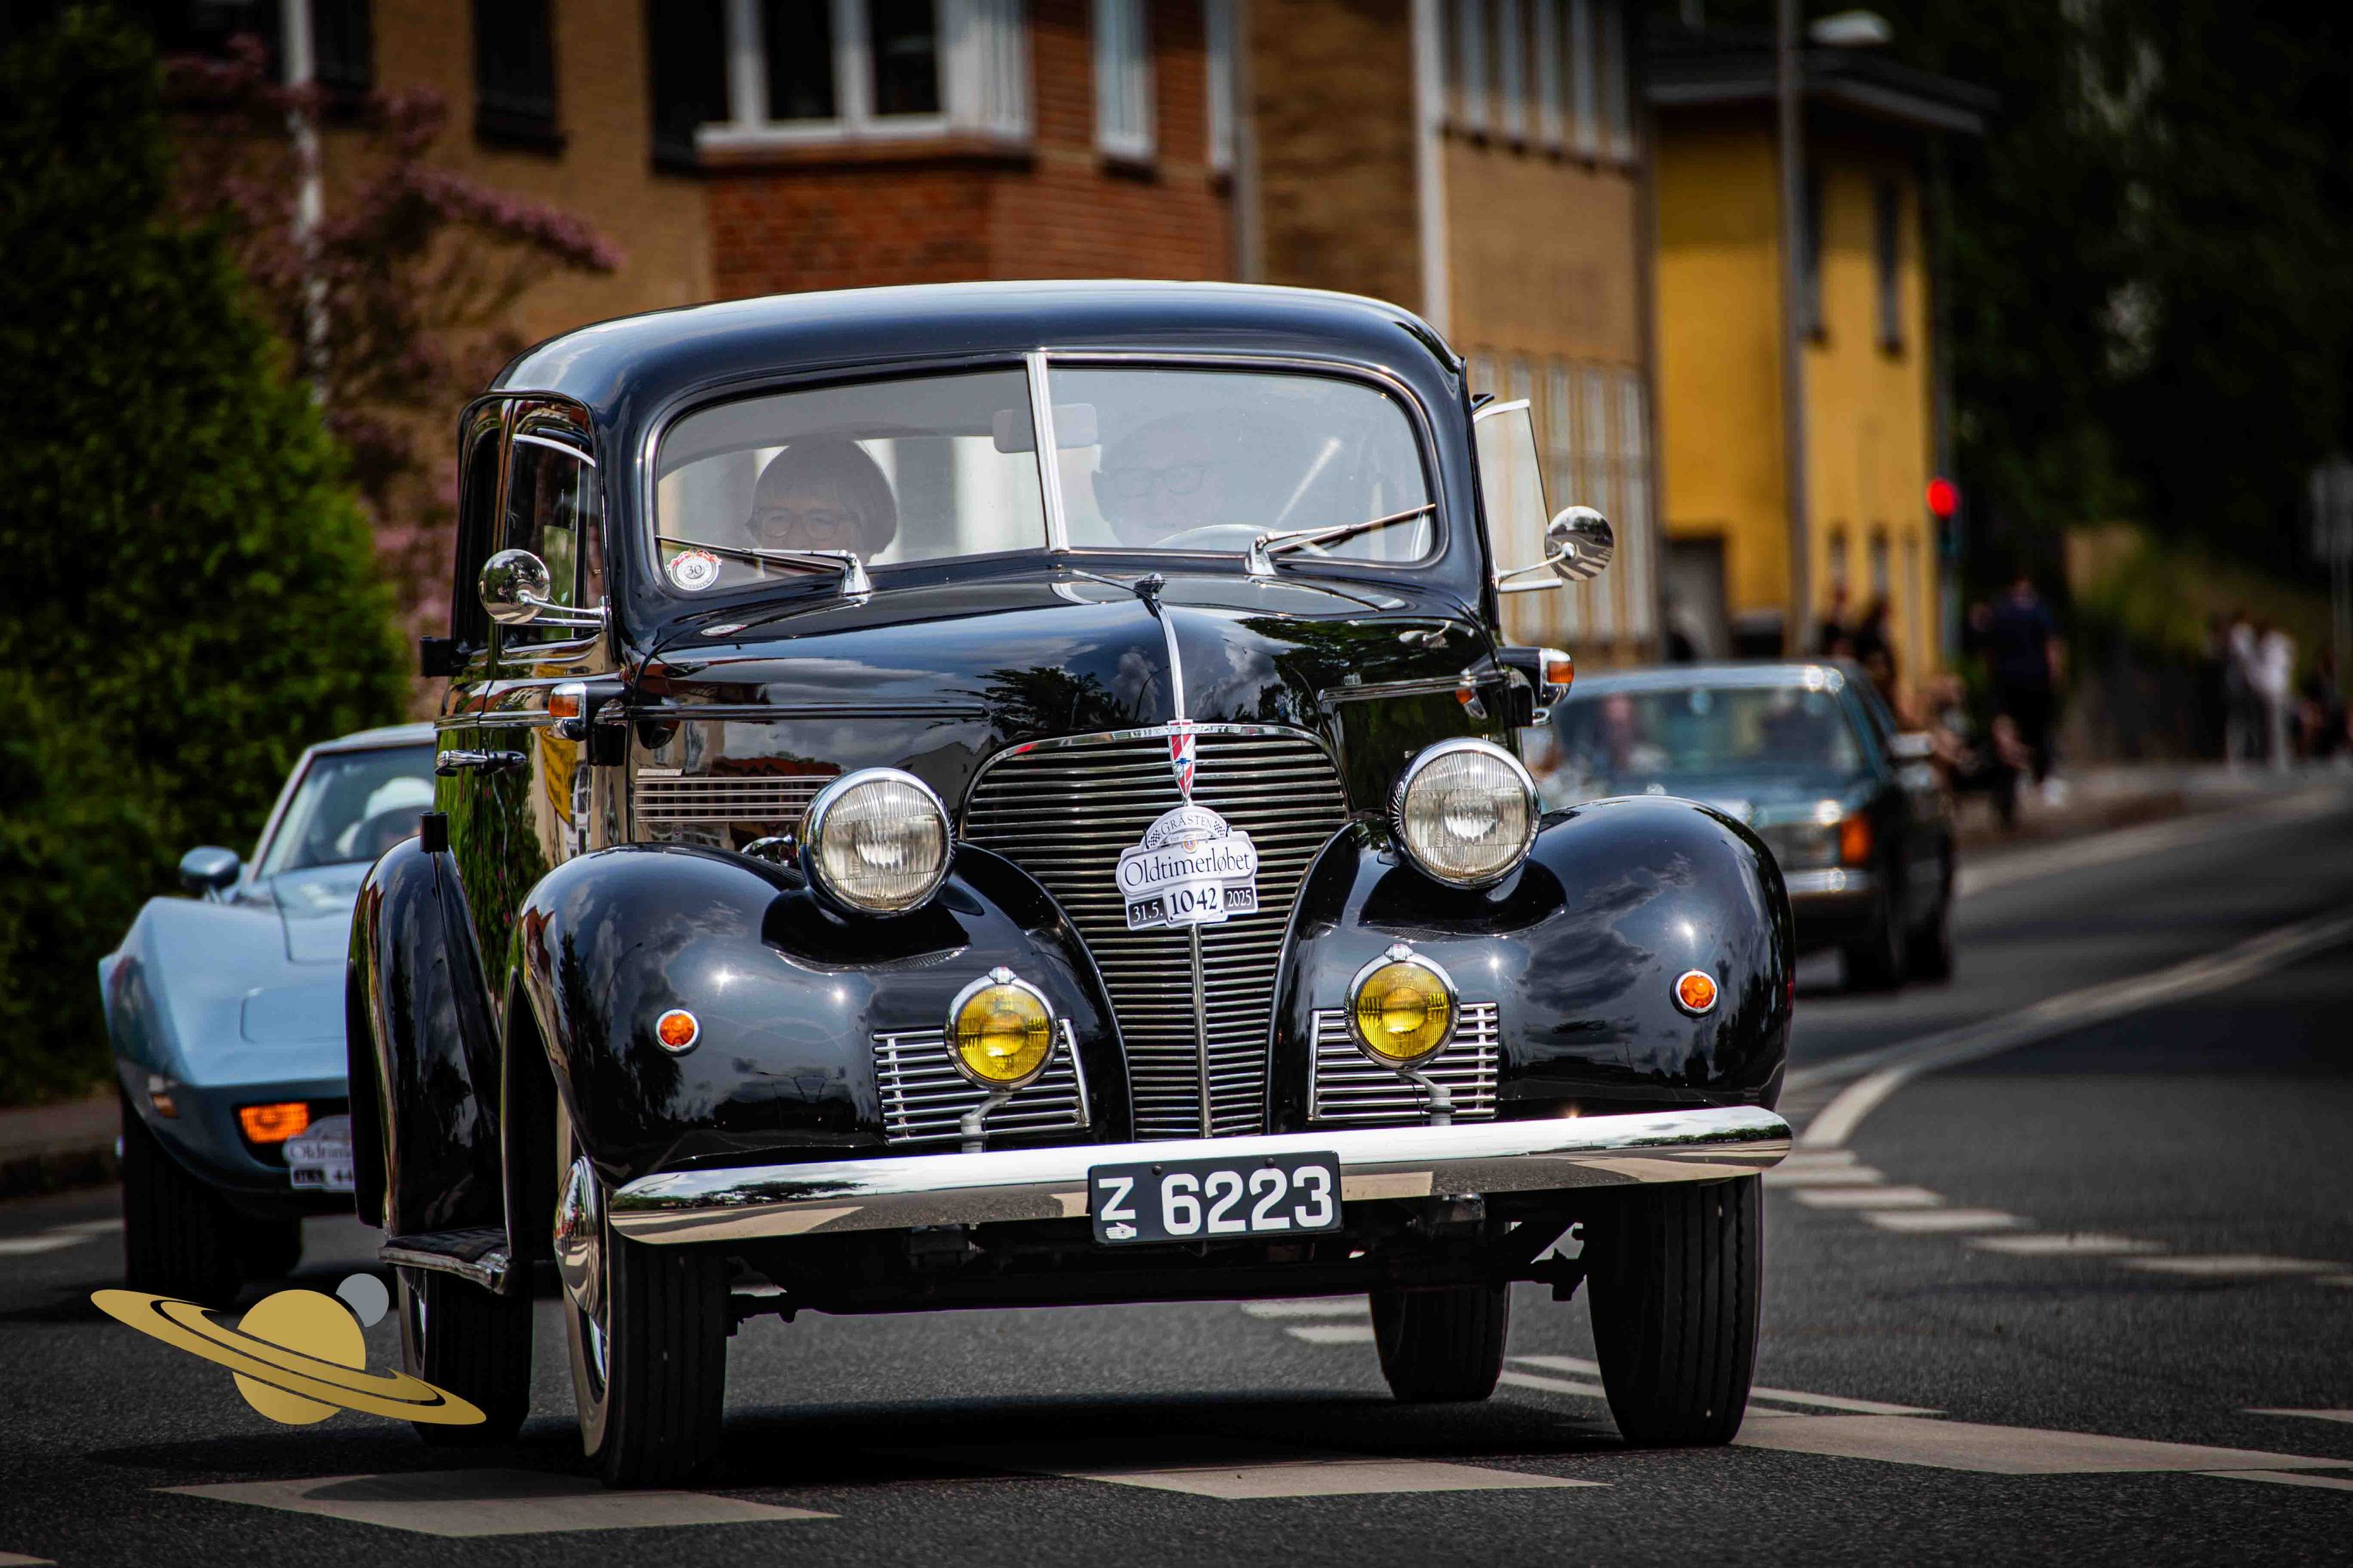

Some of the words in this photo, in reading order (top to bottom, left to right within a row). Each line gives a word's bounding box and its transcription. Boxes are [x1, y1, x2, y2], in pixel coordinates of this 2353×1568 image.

[1161, 813, 1212, 835] GRÅSTEN
[1124, 846, 1252, 887] Oldtimerløbet
[1133, 901, 1163, 923] 31.5.
[1170, 887, 1218, 916] 1042
[1227, 889, 1252, 908] 2025
[1099, 1177, 1136, 1220] Z
[1161, 1166, 1333, 1235] 6223
